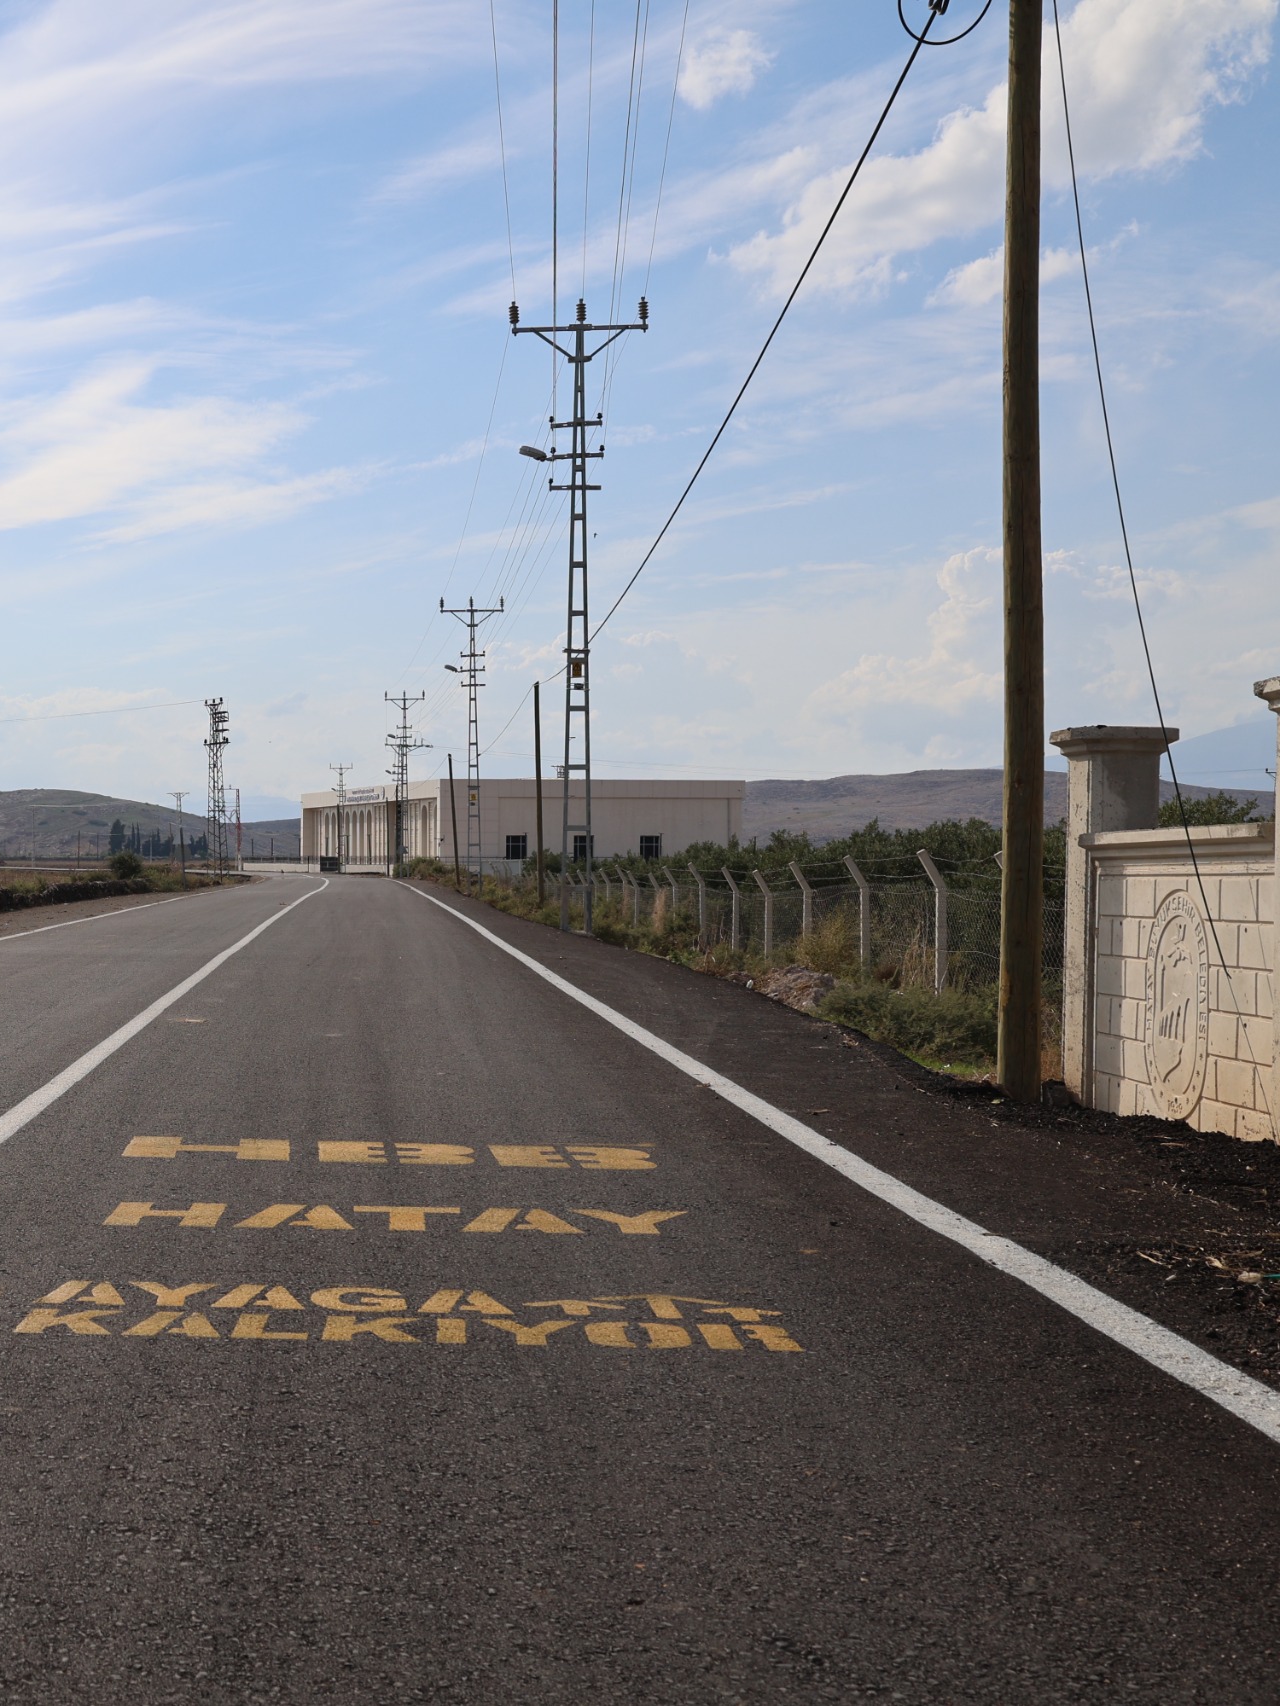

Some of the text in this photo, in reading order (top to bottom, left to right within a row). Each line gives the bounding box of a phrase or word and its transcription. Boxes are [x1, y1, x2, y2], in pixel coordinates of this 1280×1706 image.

[1146, 967, 1154, 1031] HATAY
[121, 1136, 658, 1169] HBB
[102, 1201, 688, 1234] HATAY
[12, 1308, 805, 1352] KALKIYOR
